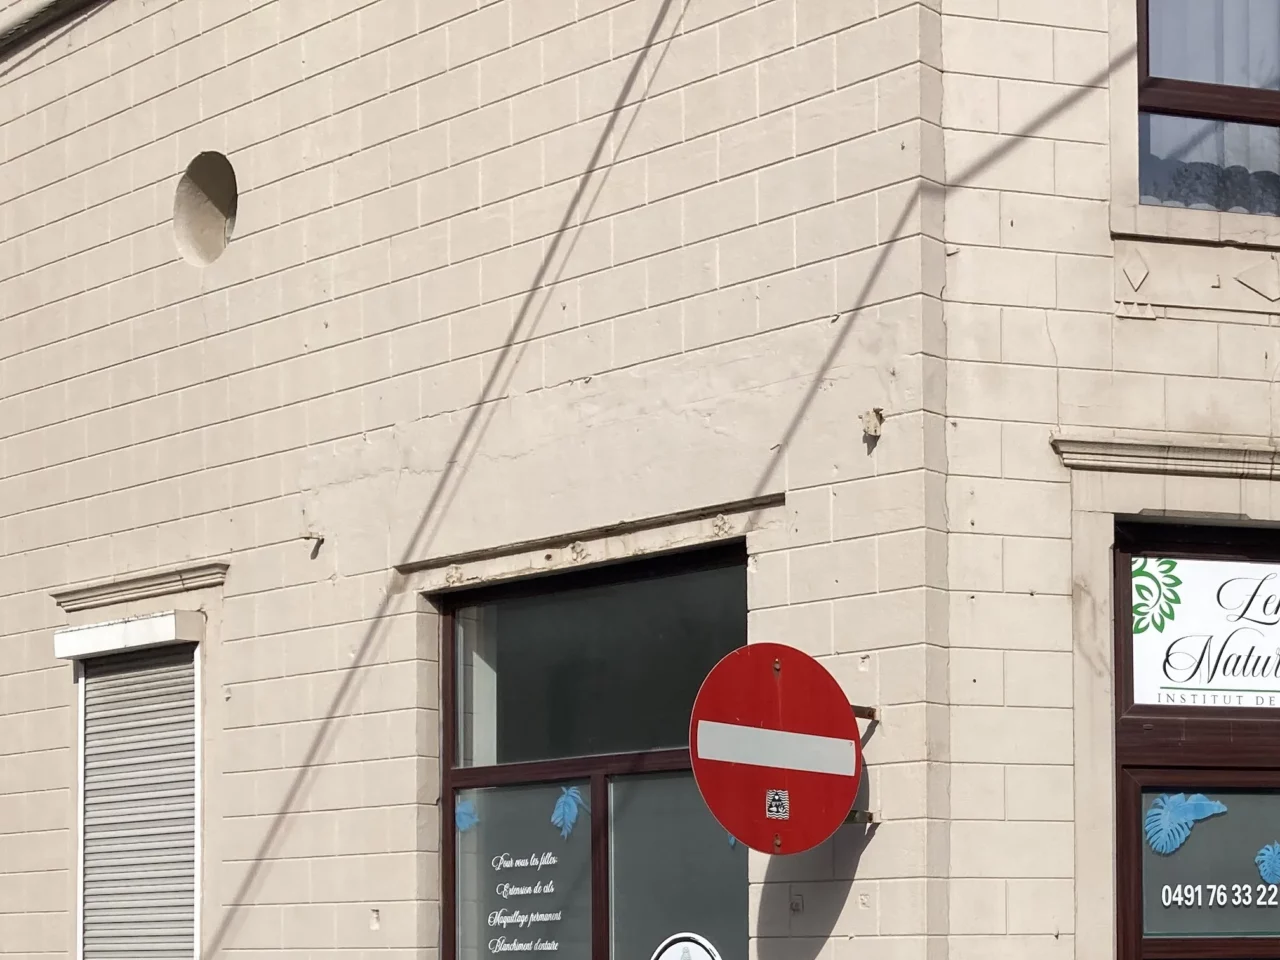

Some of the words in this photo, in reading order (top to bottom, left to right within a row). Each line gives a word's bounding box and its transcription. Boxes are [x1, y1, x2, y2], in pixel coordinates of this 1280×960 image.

[1157, 692, 1244, 706] INSTITUT
[1255, 695, 1276, 706] DE
[533, 880, 542, 894] de
[1161, 884, 1203, 907] 0491
[1206, 884, 1228, 907] 76
[1231, 884, 1253, 907] 33
[1256, 884, 1279, 907] 22
